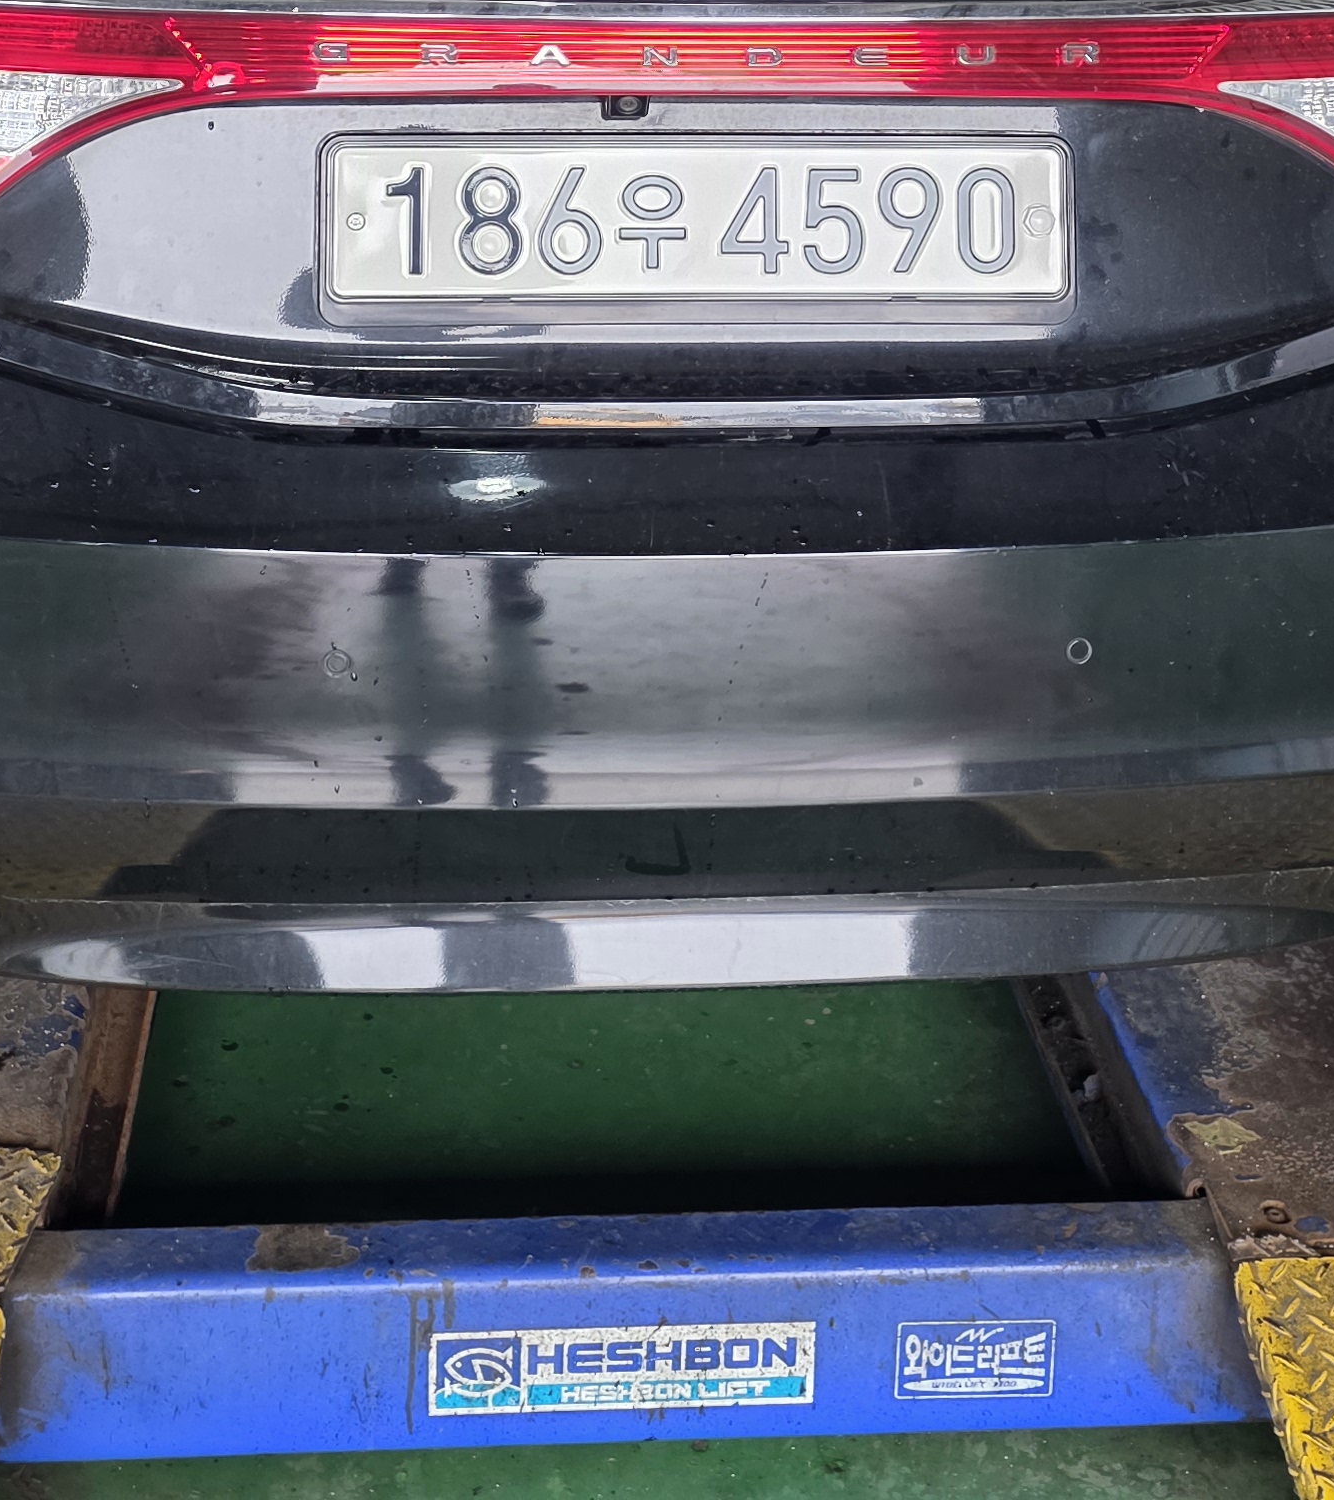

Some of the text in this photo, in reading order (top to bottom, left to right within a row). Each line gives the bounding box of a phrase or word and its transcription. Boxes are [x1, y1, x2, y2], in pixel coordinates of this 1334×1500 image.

[311, 41, 1101, 68] GRANDEUR
[385, 163, 1017, 276] 186우 4590
[527, 1336, 798, 1376] HESHBON
[903, 1331, 1047, 1379] 와이드리프트
[560, 1380, 771, 1403] HESHBON LIFT
